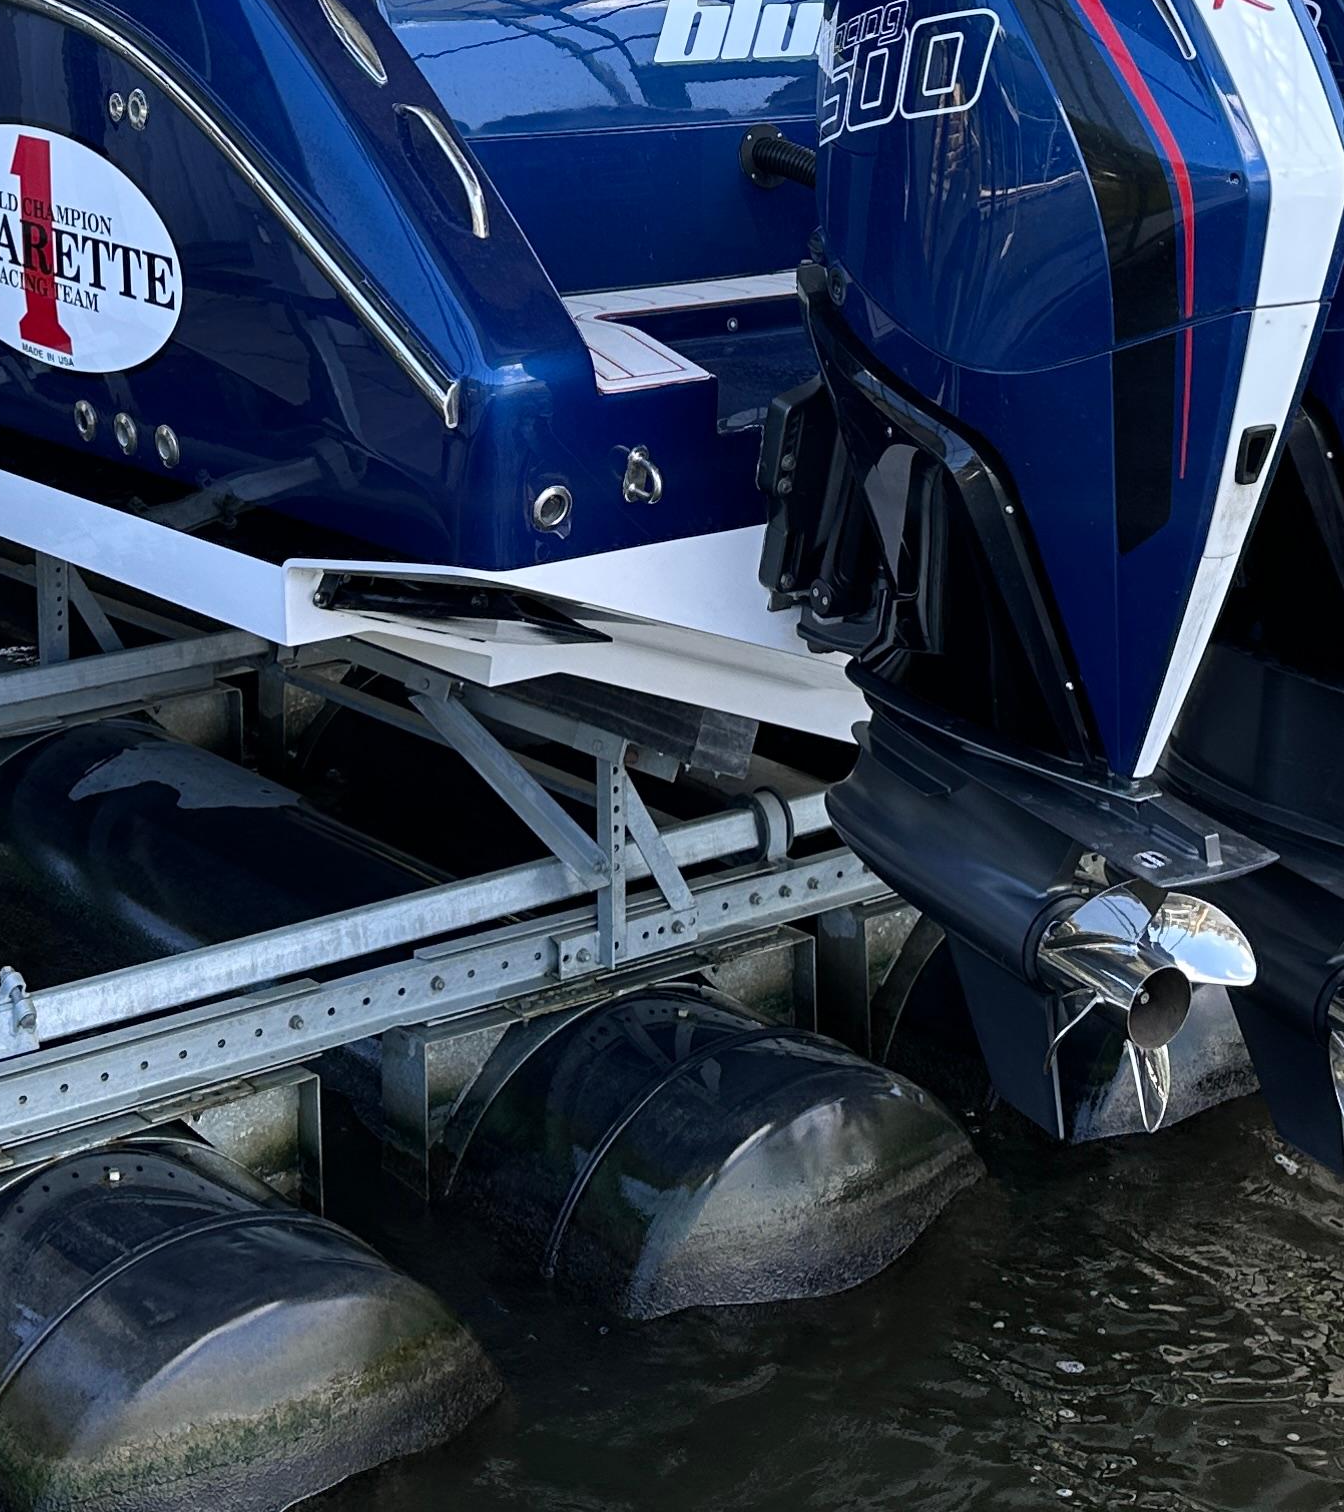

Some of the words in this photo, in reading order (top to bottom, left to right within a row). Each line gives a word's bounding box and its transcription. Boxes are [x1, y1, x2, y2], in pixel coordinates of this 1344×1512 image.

[21, 197, 112, 236] CHAMPION
[54, 282, 100, 313] TEAM
[21, 342, 44, 359] MADE
[46, 351, 55, 363] IN
[58, 356, 75, 367] USA
